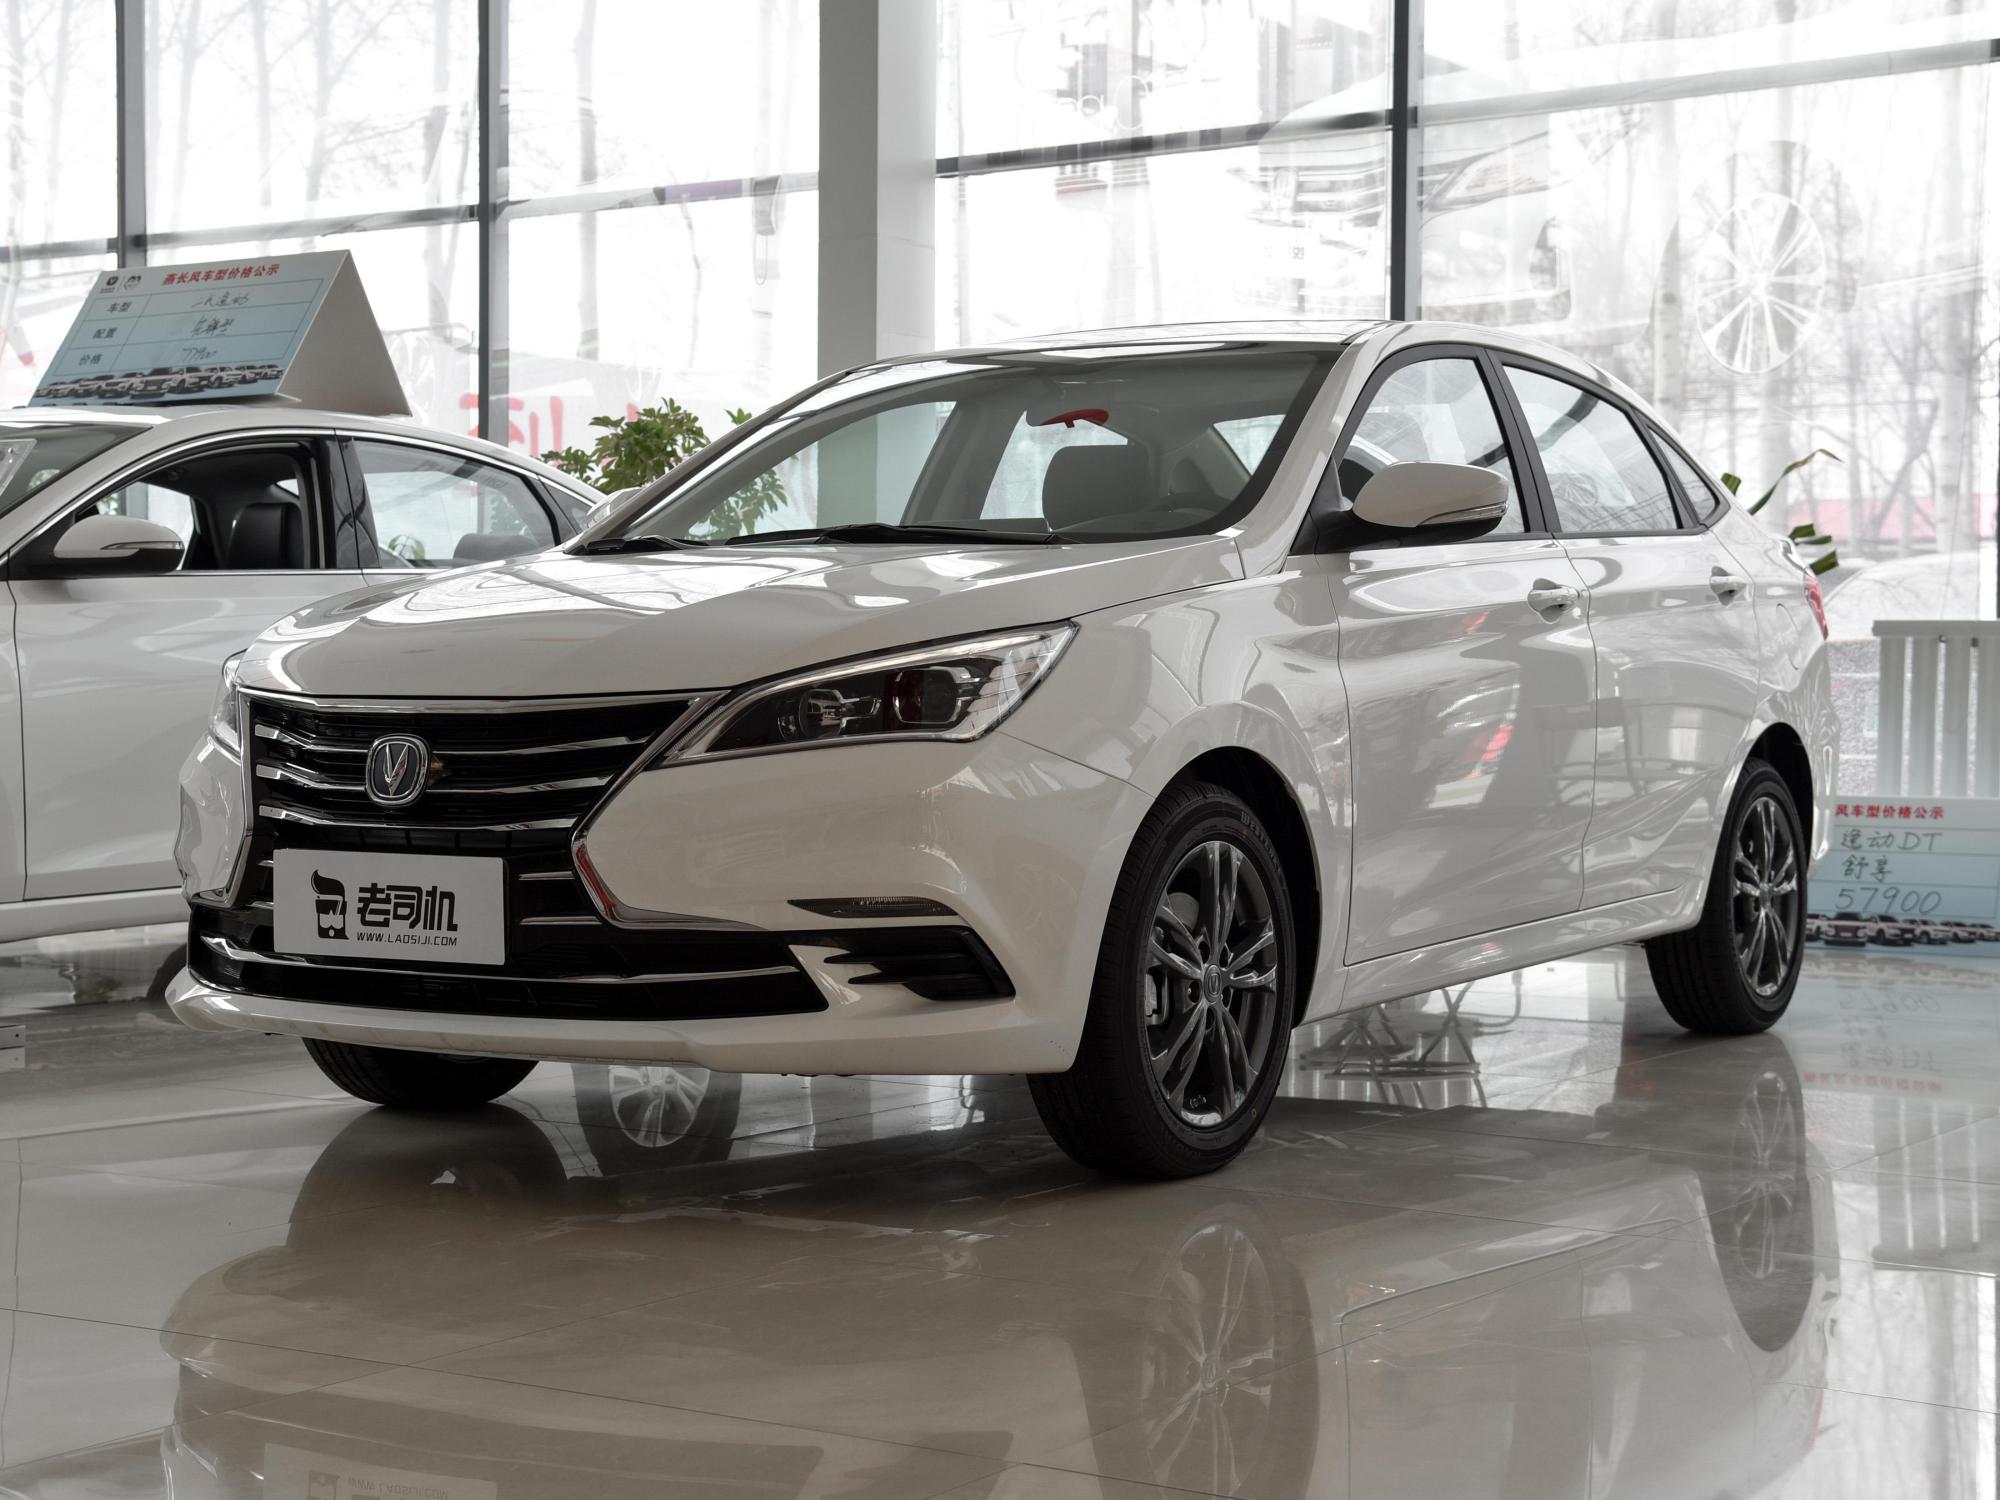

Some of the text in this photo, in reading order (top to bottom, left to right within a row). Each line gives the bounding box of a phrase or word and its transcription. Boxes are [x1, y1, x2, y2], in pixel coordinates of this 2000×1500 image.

[106, 301, 132, 313] 车型
[92, 326, 118, 340] 配置
[78, 352, 103, 367] 价格
[1835, 804, 1944, 819] 风车型价格公示
[357, 882, 458, 932] 老司机
[1834, 886, 1942, 914] 57900
[356, 931, 458, 947] WWW.LAOSIJI.COM
